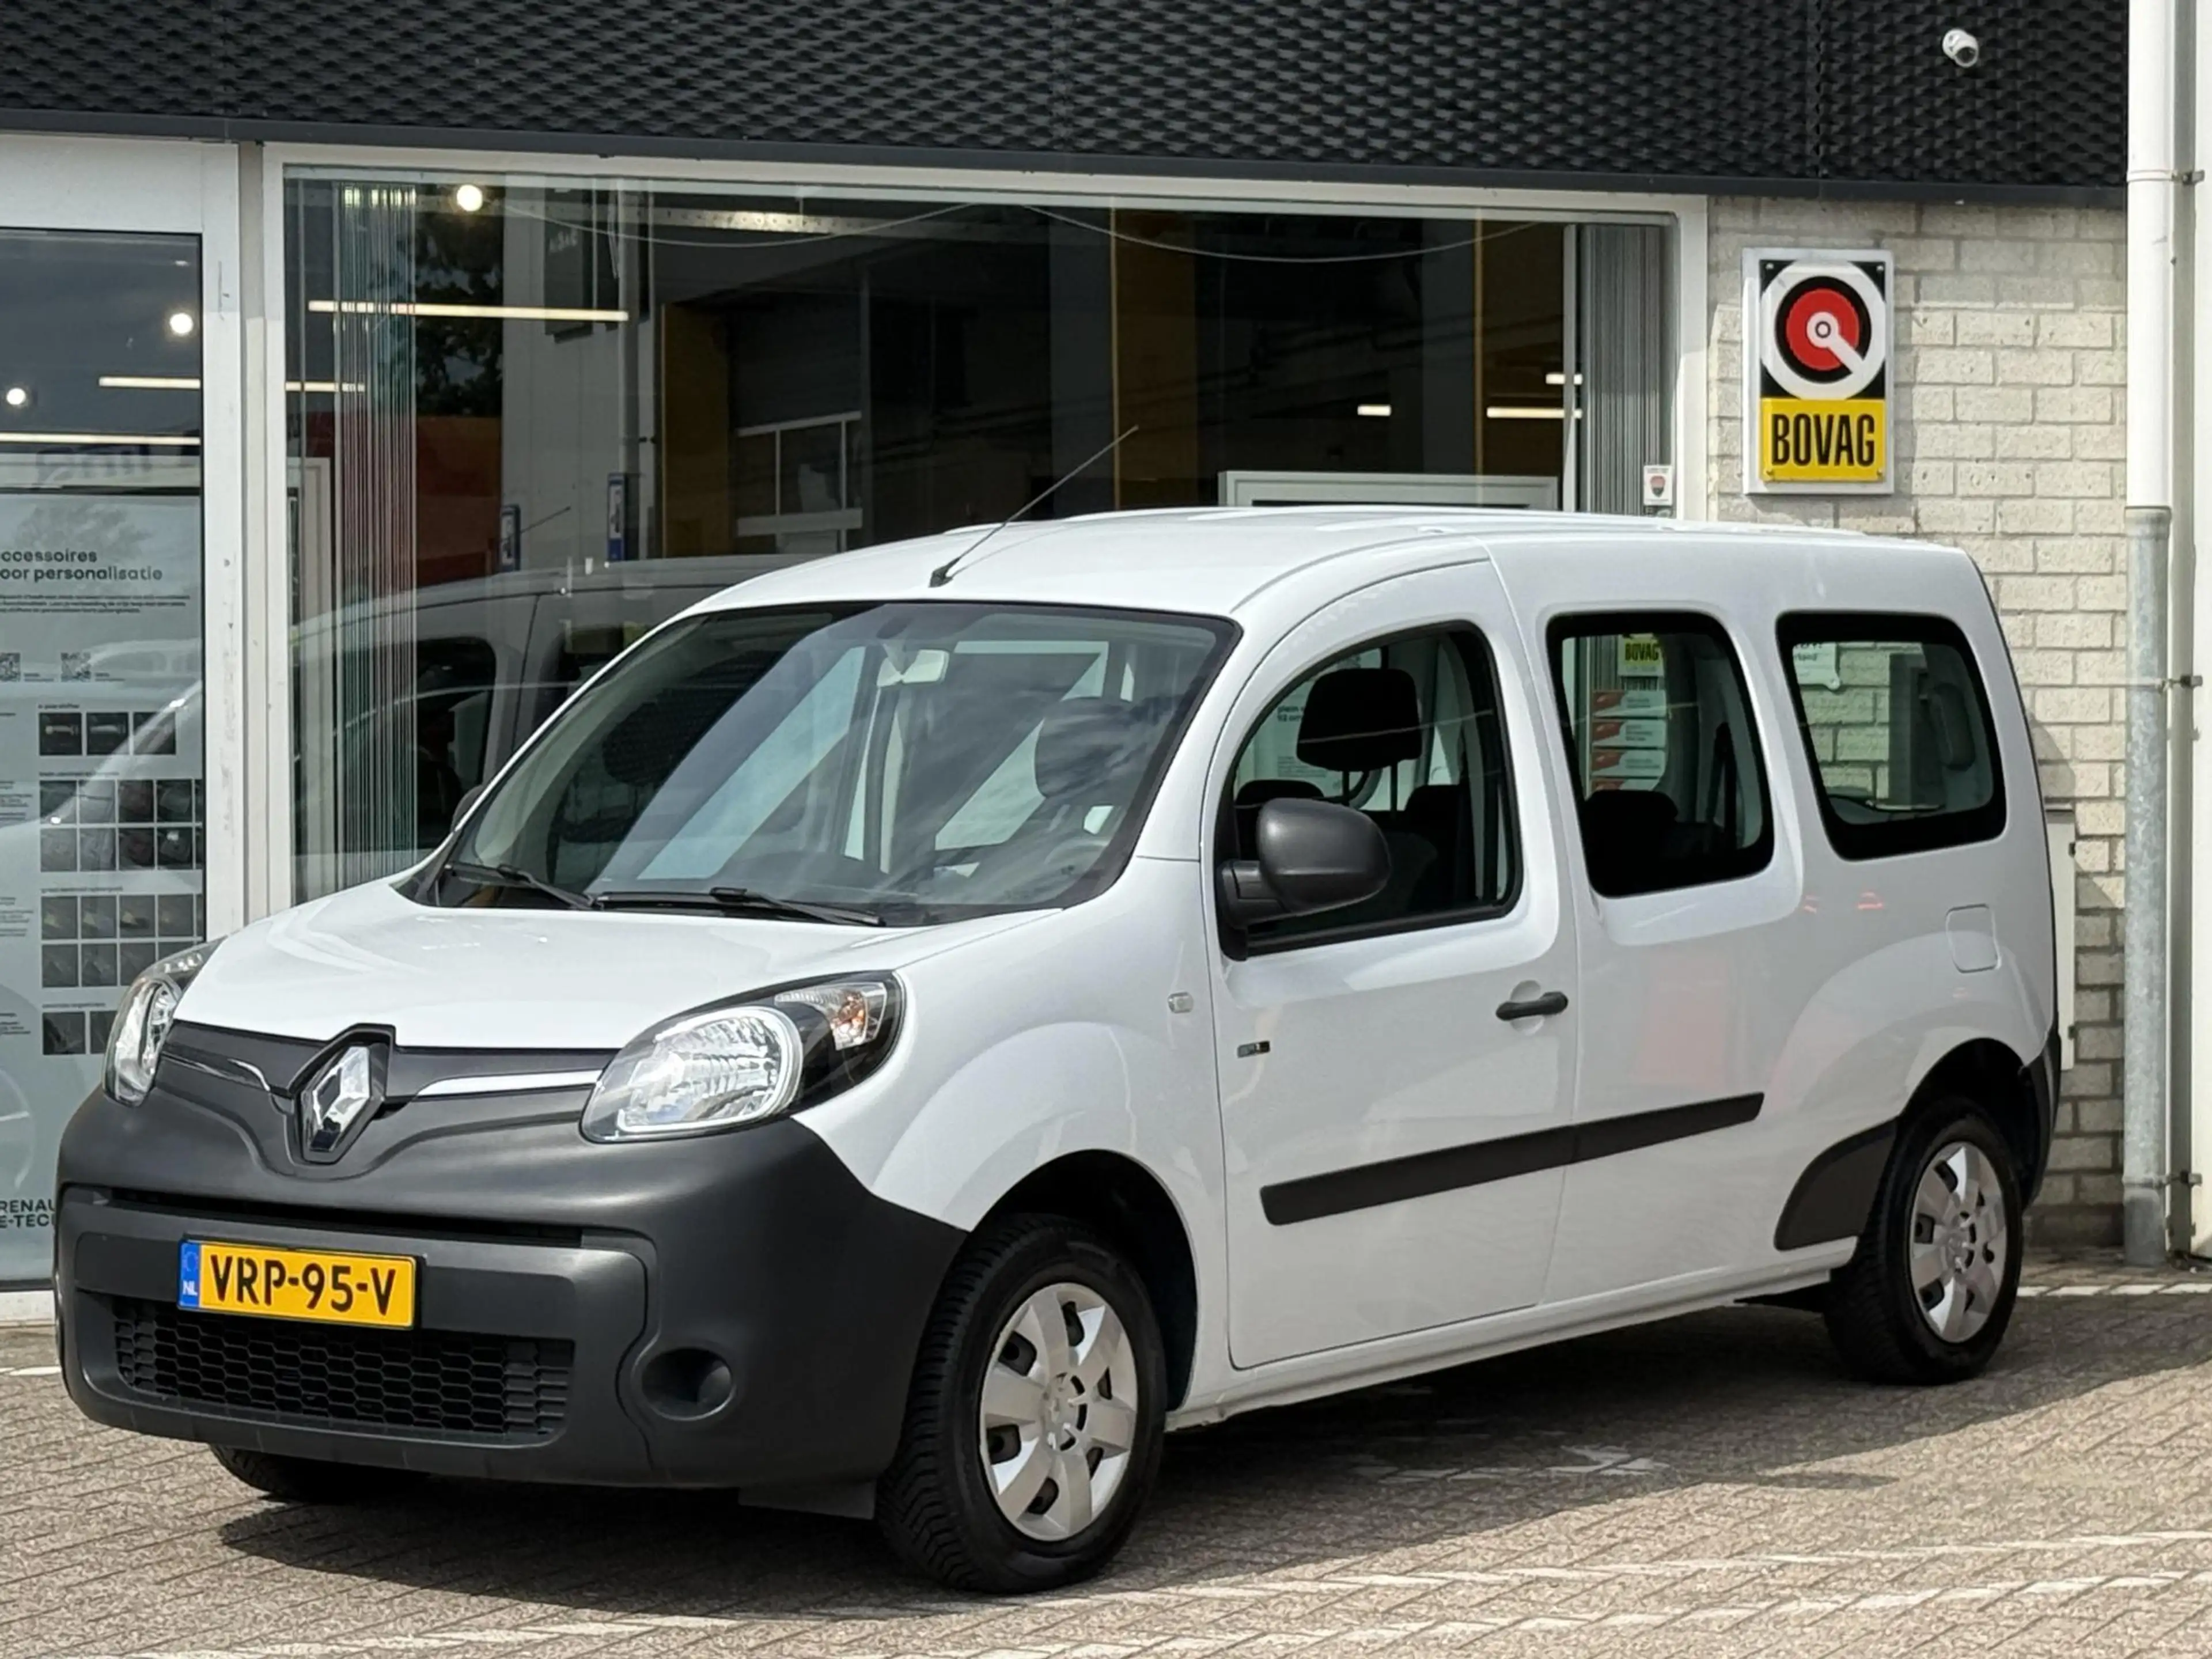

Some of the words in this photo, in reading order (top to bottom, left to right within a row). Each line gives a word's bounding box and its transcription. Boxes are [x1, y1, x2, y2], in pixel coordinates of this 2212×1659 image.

[1771, 414, 1874, 467] BOVAG
[0, 548, 97, 562] ccessoires
[0, 569, 29, 580] oor
[33, 566, 163, 583] personalisatie
[1625, 642, 1660, 661] BOVAG
[0, 1199, 56, 1213] RENAU
[0, 1213, 52, 1228] E-TEC
[182, 1280, 198, 1297] NL
[210, 1254, 396, 1316] VRP-95-V
